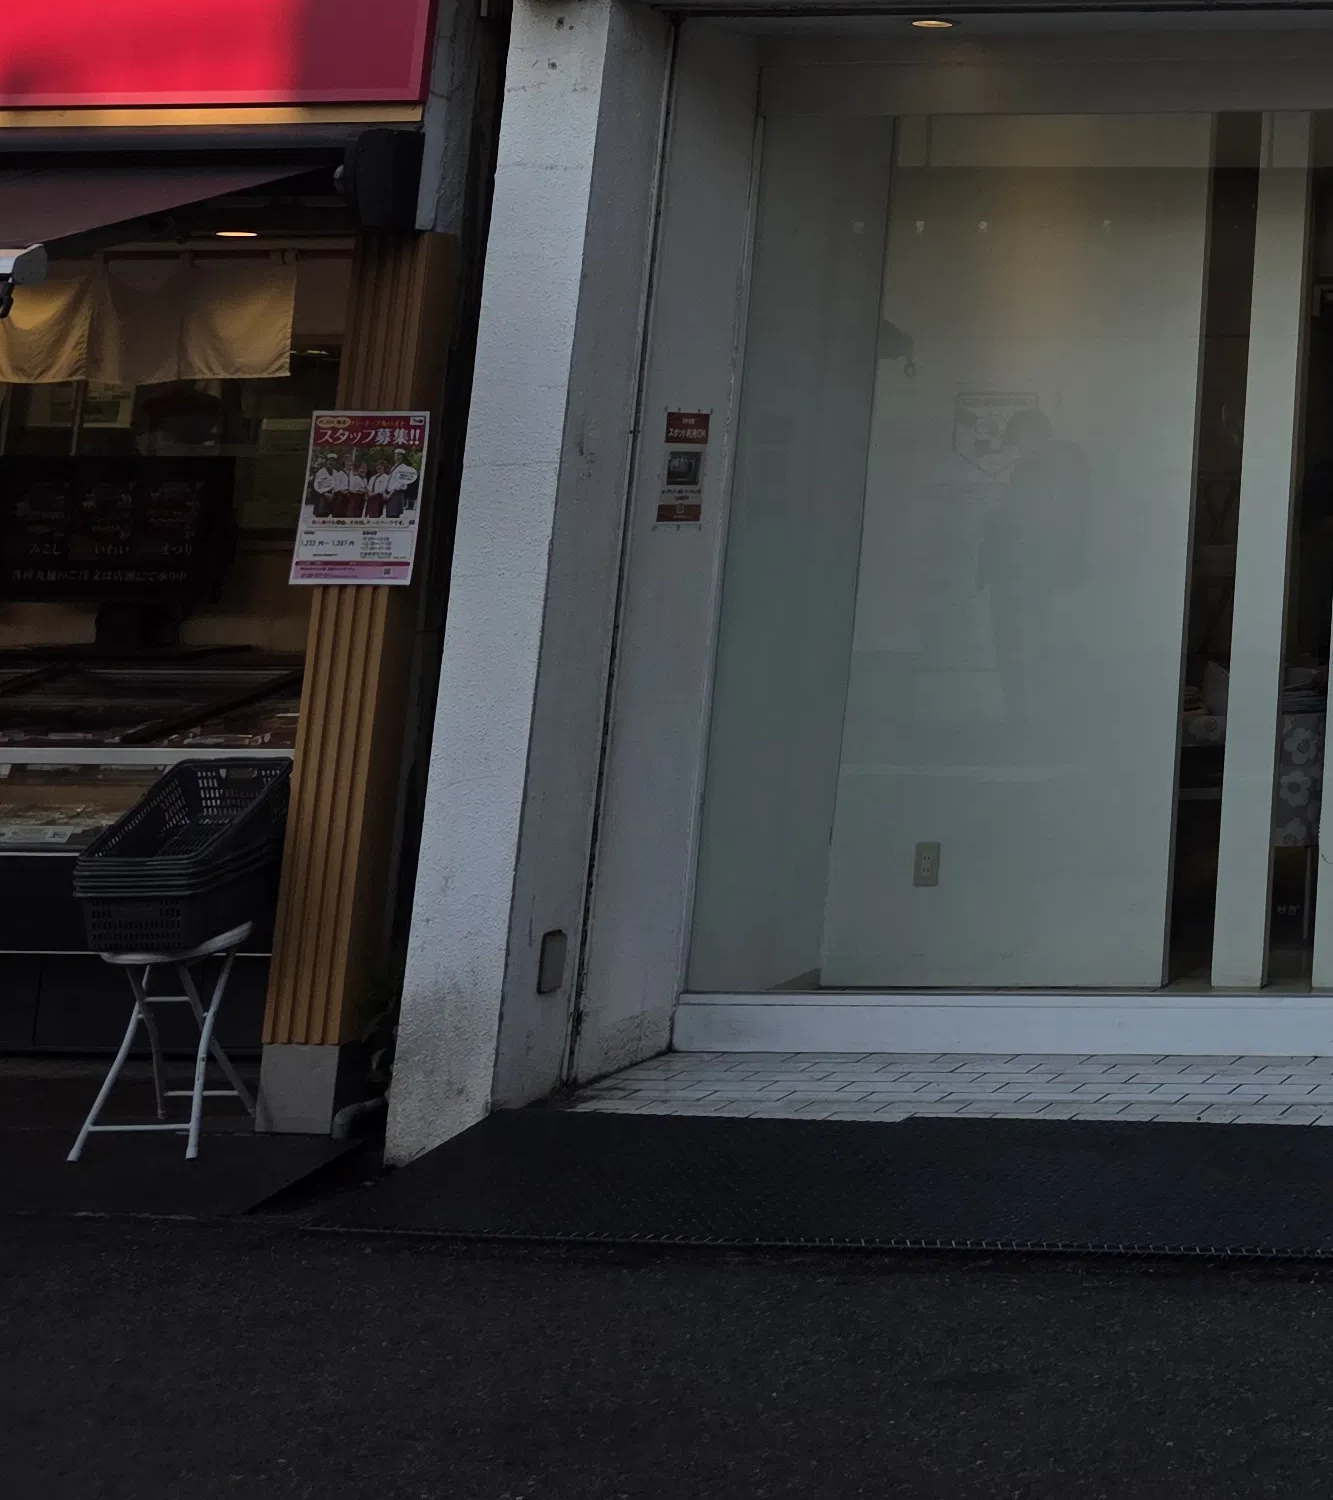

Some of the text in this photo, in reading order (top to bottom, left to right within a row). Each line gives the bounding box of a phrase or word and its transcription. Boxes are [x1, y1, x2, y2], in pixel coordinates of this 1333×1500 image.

[317, 428, 421, 445] スタッフ募集!!
